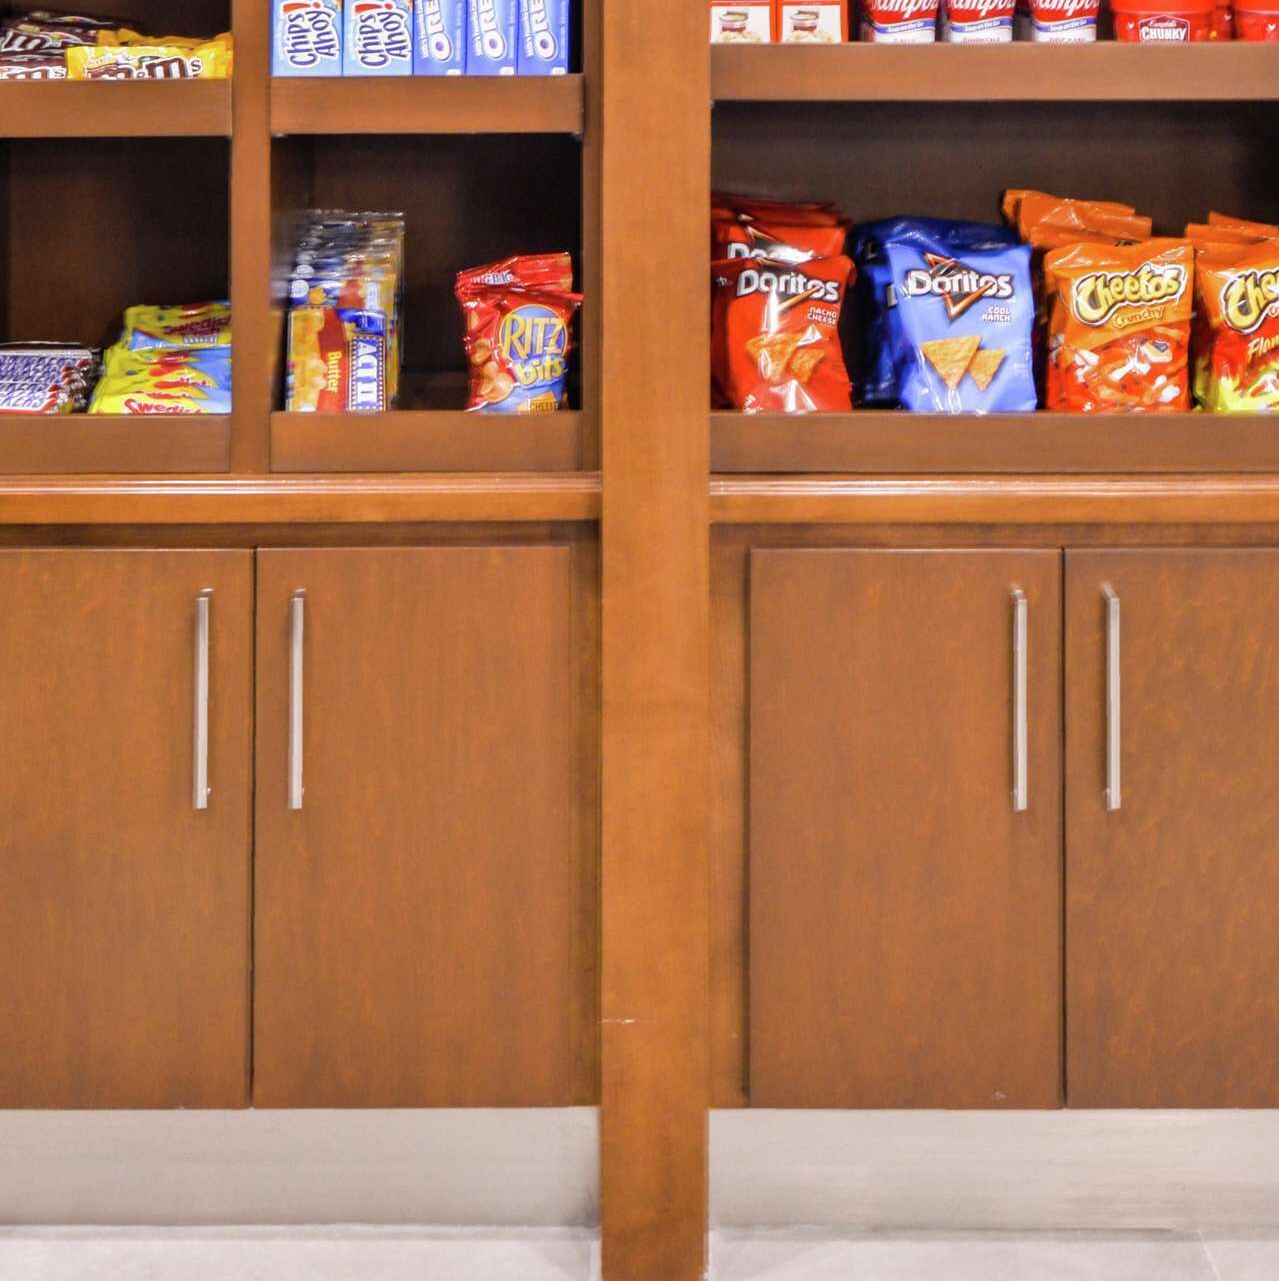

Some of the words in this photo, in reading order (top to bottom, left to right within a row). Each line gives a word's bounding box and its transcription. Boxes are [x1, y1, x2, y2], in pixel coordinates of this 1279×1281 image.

[287, 12, 318, 66] Chips
[359, 13, 390, 67] Chips
[1141, 26, 1187, 41] CHUNKY
[736, 269, 840, 303] Doritos
[908, 270, 1014, 298] Doritos
[1075, 265, 1184, 324] Cheetos
[807, 314, 837, 325] CHEESE
[809, 306, 837, 318] NACHO
[988, 306, 1010, 315] COOL
[1114, 305, 1167, 328] Crunchy
[504, 313, 564, 361] RITZ
[327, 351, 343, 393] Butter
[515, 356, 565, 386] bits
